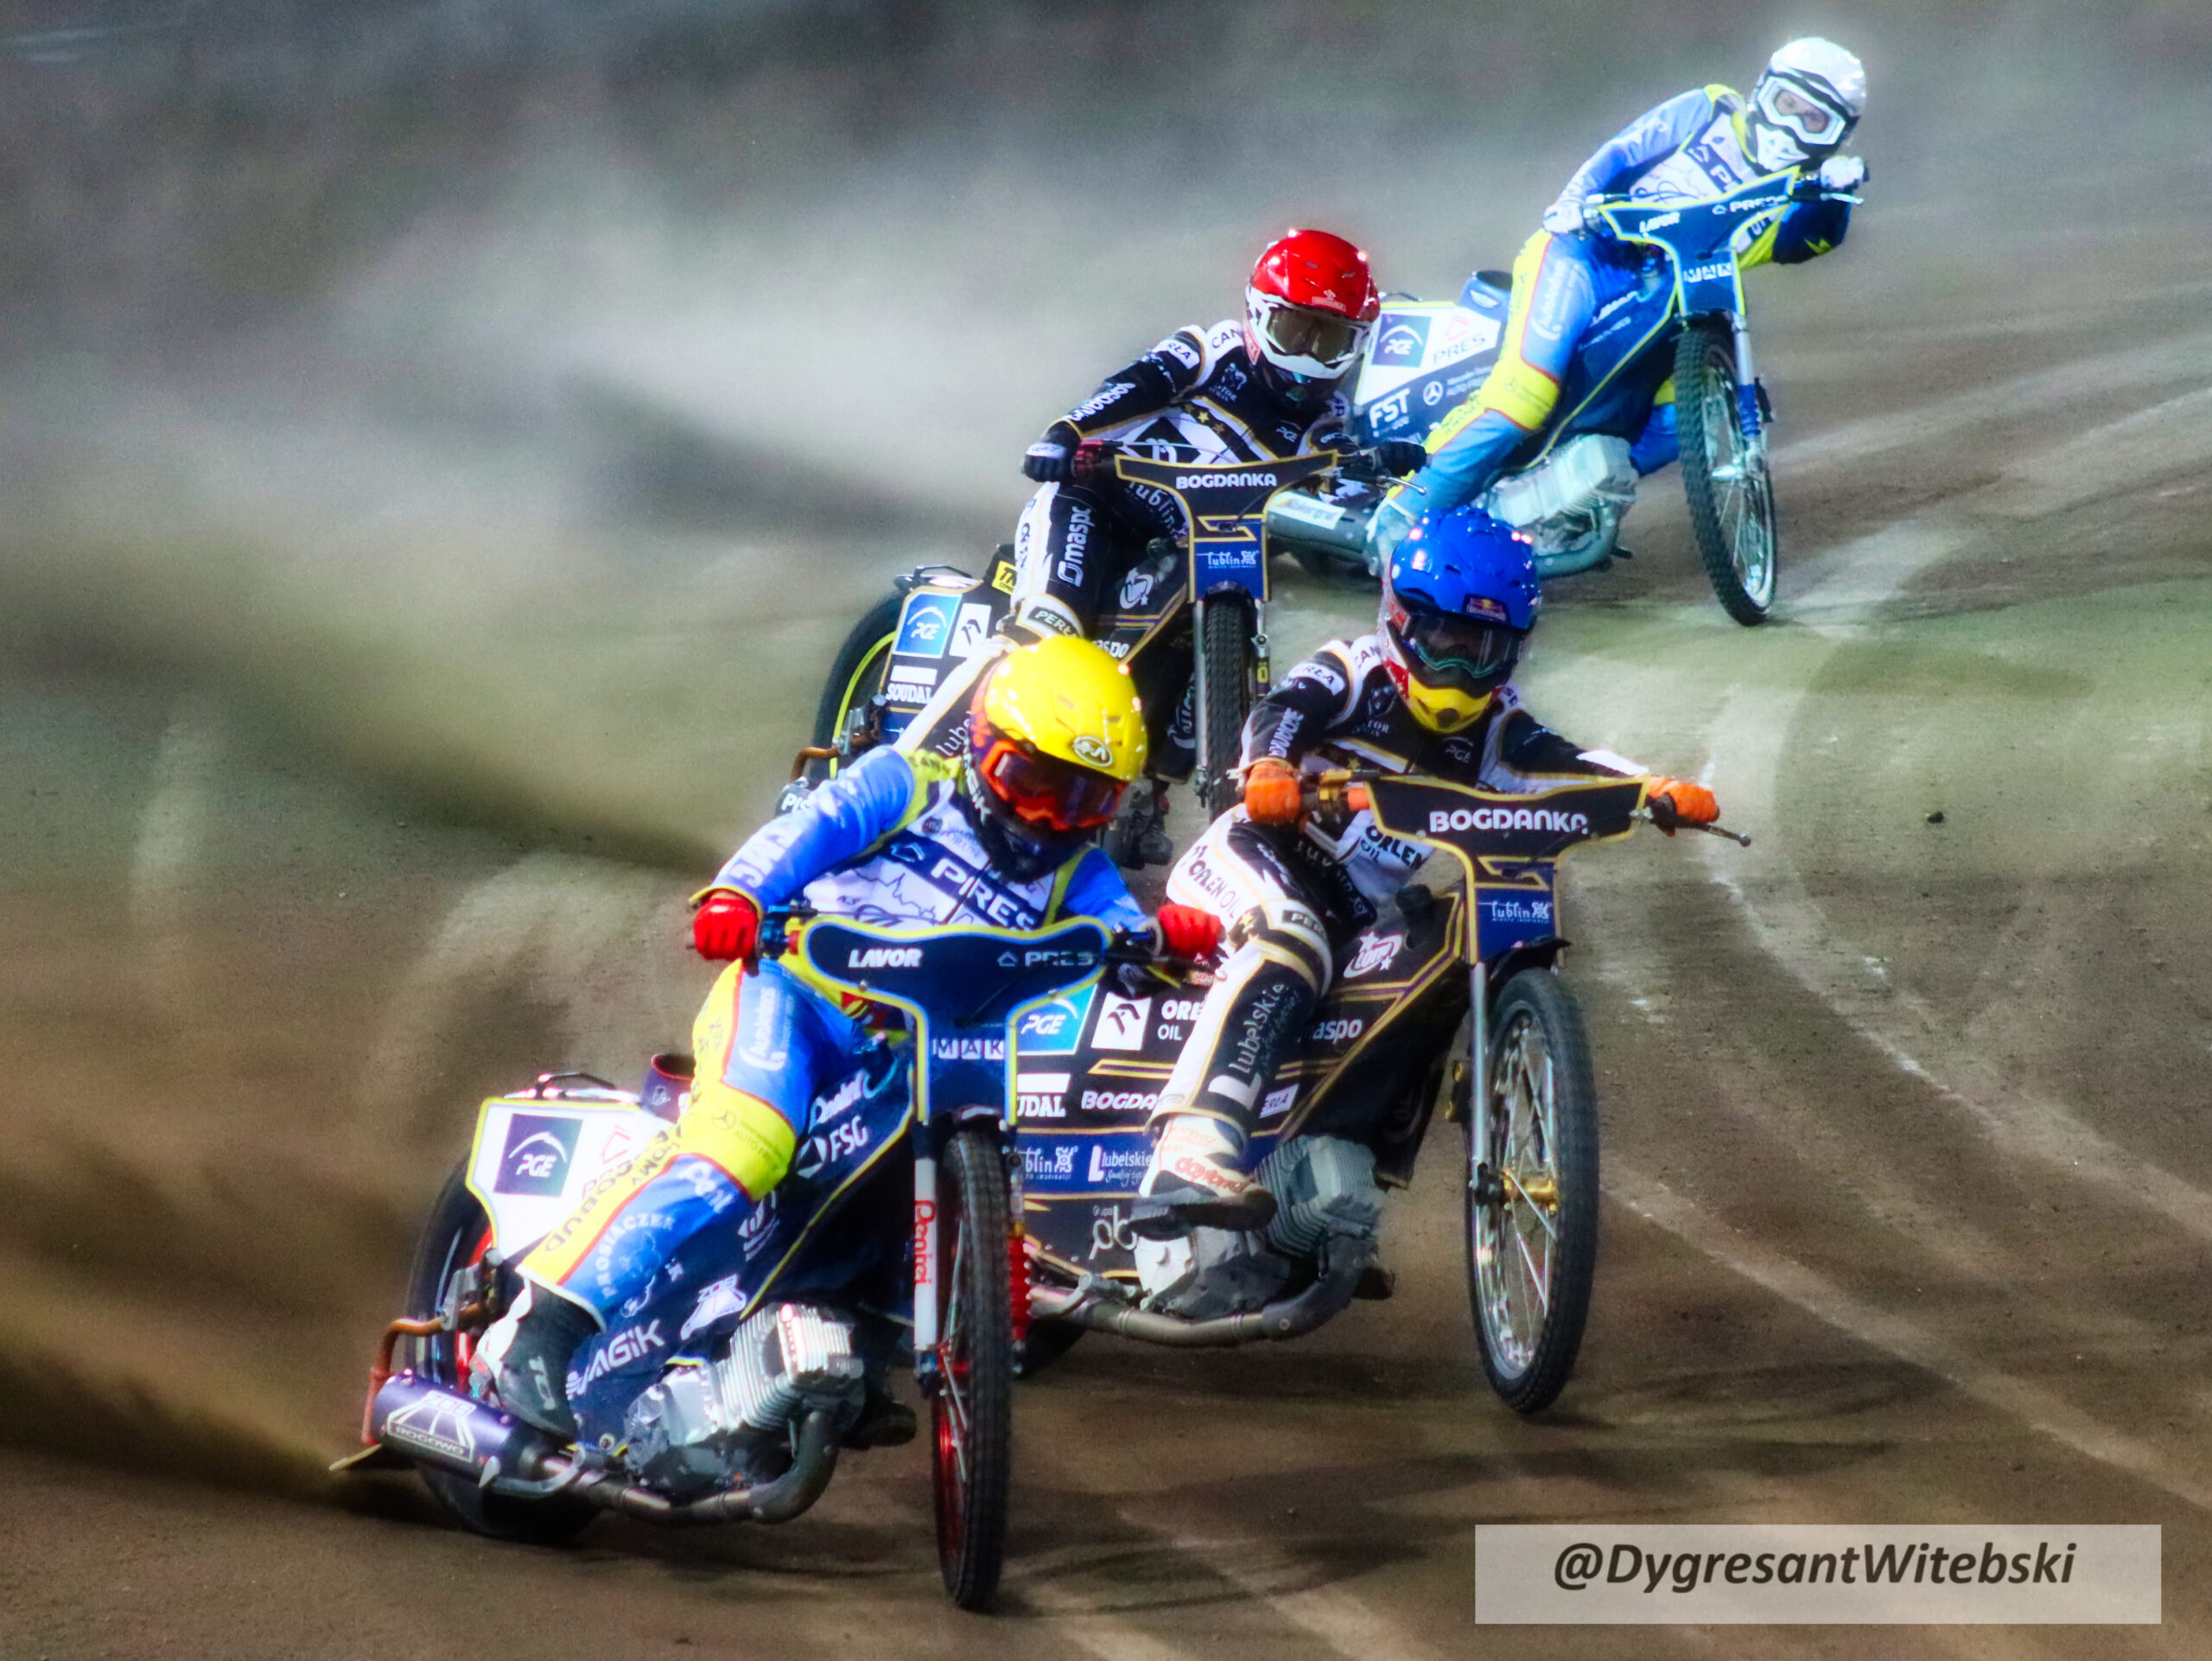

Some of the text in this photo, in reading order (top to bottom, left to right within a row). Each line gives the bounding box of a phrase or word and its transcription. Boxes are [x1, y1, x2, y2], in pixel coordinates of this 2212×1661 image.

[1370, 388, 1411, 429] FST
[1175, 472, 1277, 490] BOGDANKA
[1428, 808, 1589, 835] BOGDANKA
[847, 948, 924, 969] LAVOR
[1020, 1015, 1066, 1035] PGE
[1157, 1024, 1182, 1041] OIL
[1312, 1018, 1363, 1045] aspo
[515, 1153, 557, 1179] PGE
